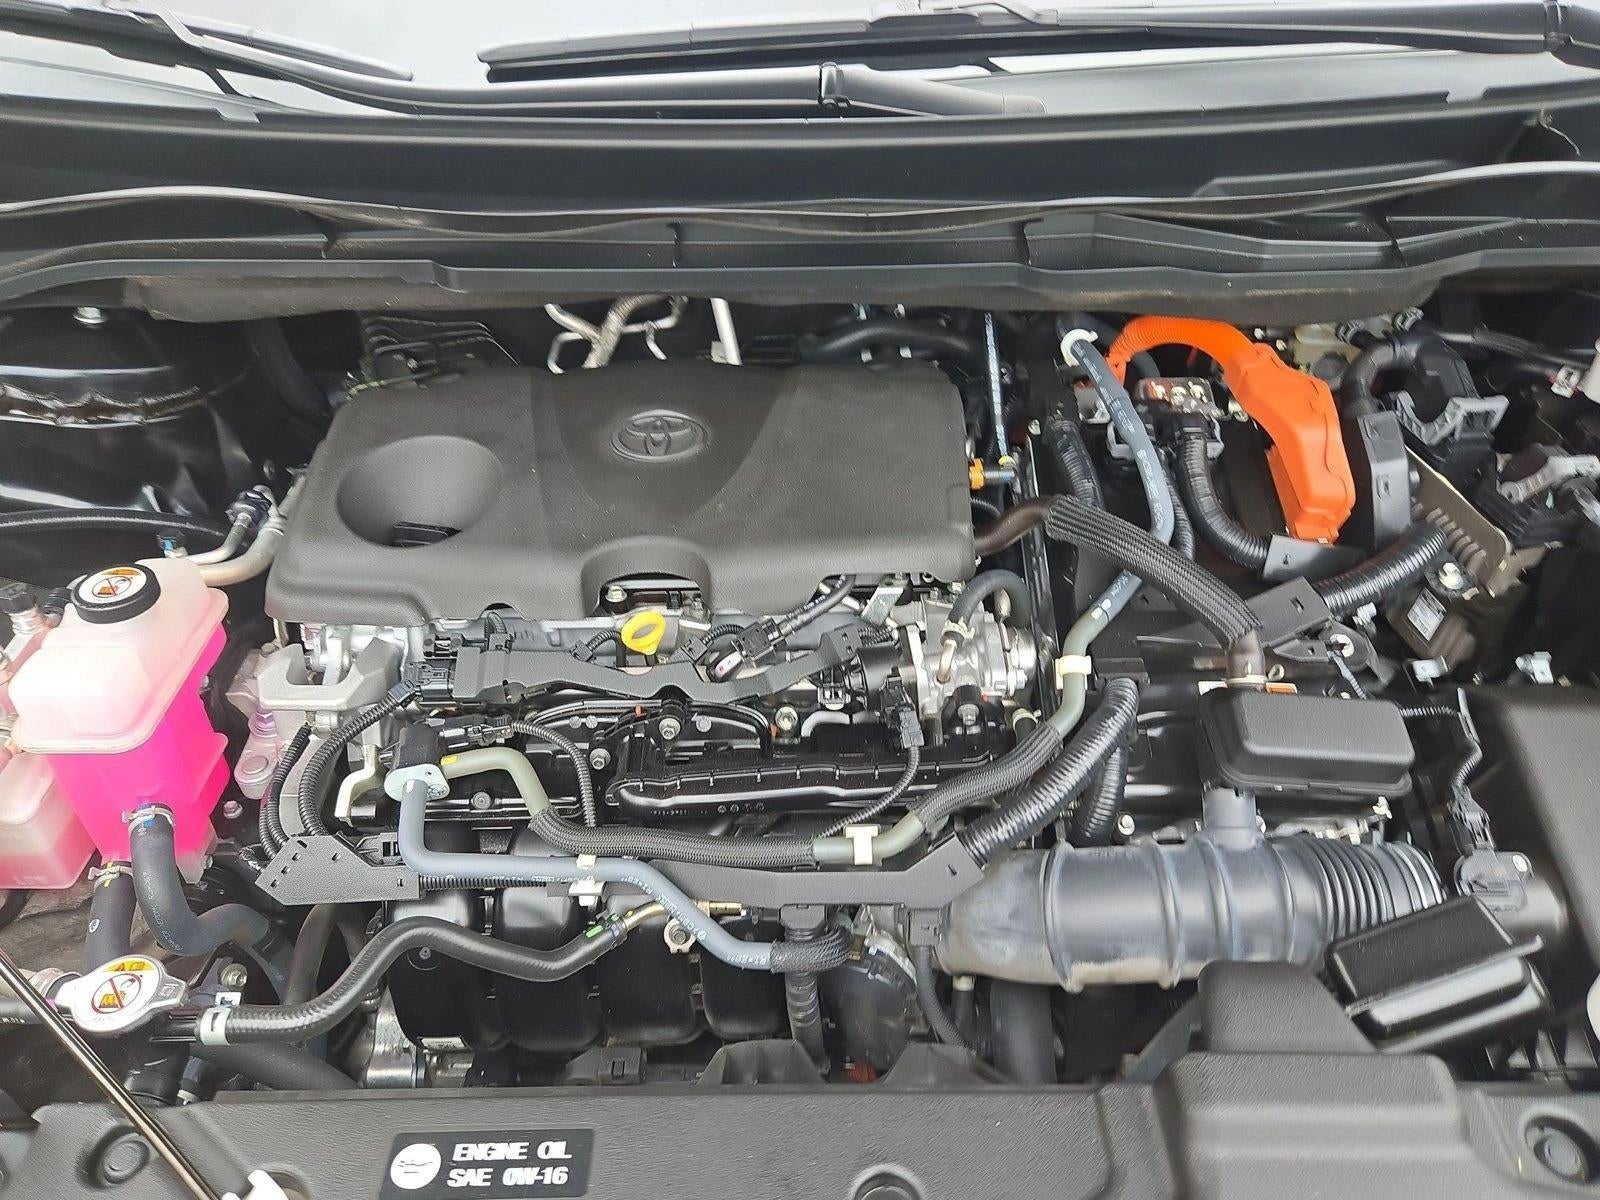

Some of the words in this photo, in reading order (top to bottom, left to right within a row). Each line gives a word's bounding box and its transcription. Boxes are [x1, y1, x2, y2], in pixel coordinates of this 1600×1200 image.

[452, 1142, 529, 1161] ENGINE
[537, 1141, 572, 1160] OIL
[447, 1168, 493, 1187] SAE
[503, 1166, 568, 1186] 0W-16
